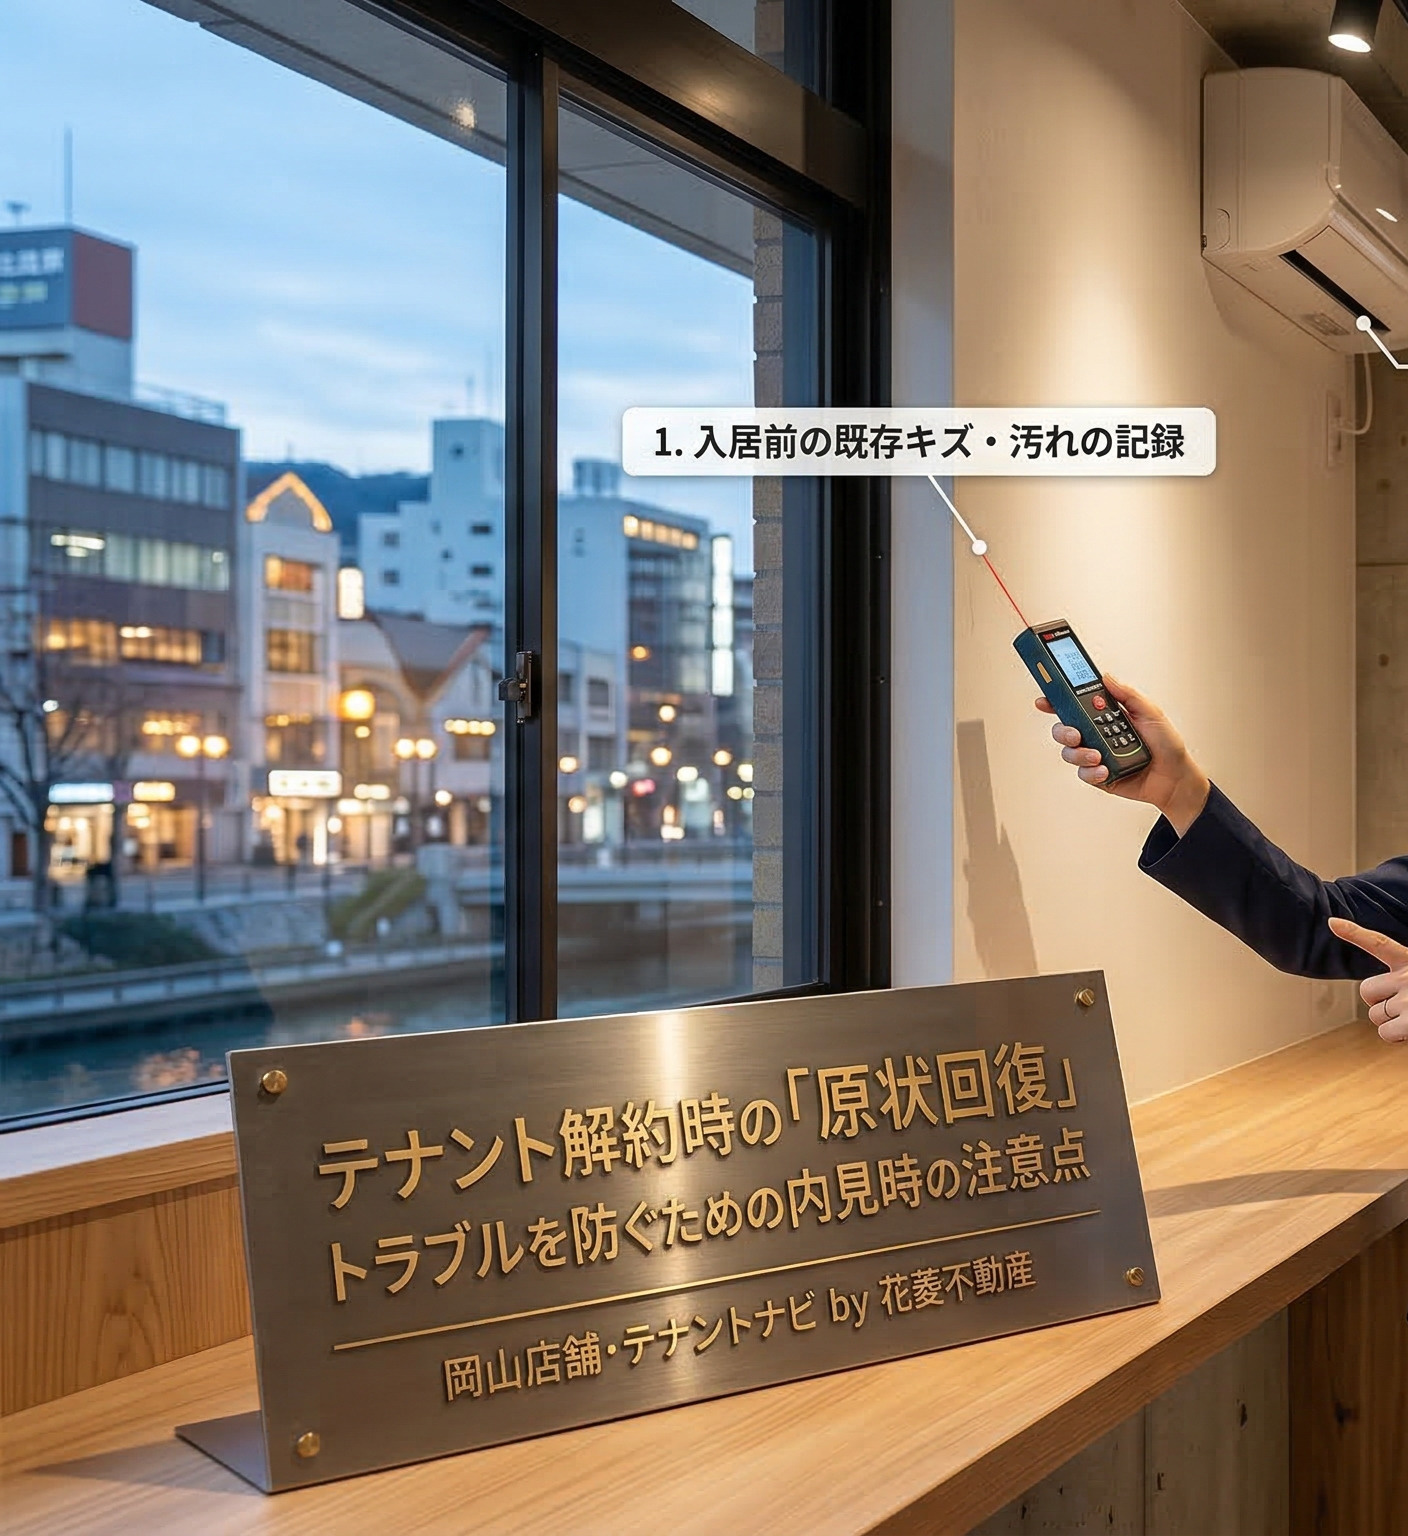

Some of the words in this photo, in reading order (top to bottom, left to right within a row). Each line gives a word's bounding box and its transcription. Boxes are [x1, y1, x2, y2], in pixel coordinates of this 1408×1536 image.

[319, 1042, 1076, 1209] テナント解約時の「原状回復」
[331, 1127, 1091, 1301] トラブルを防ぐための内見時の注意点
[443, 1290, 817, 1402] 岡山店舗・テナントナビ
[829, 1288, 868, 1328] by
[878, 1250, 1036, 1317] 花菱不動産
